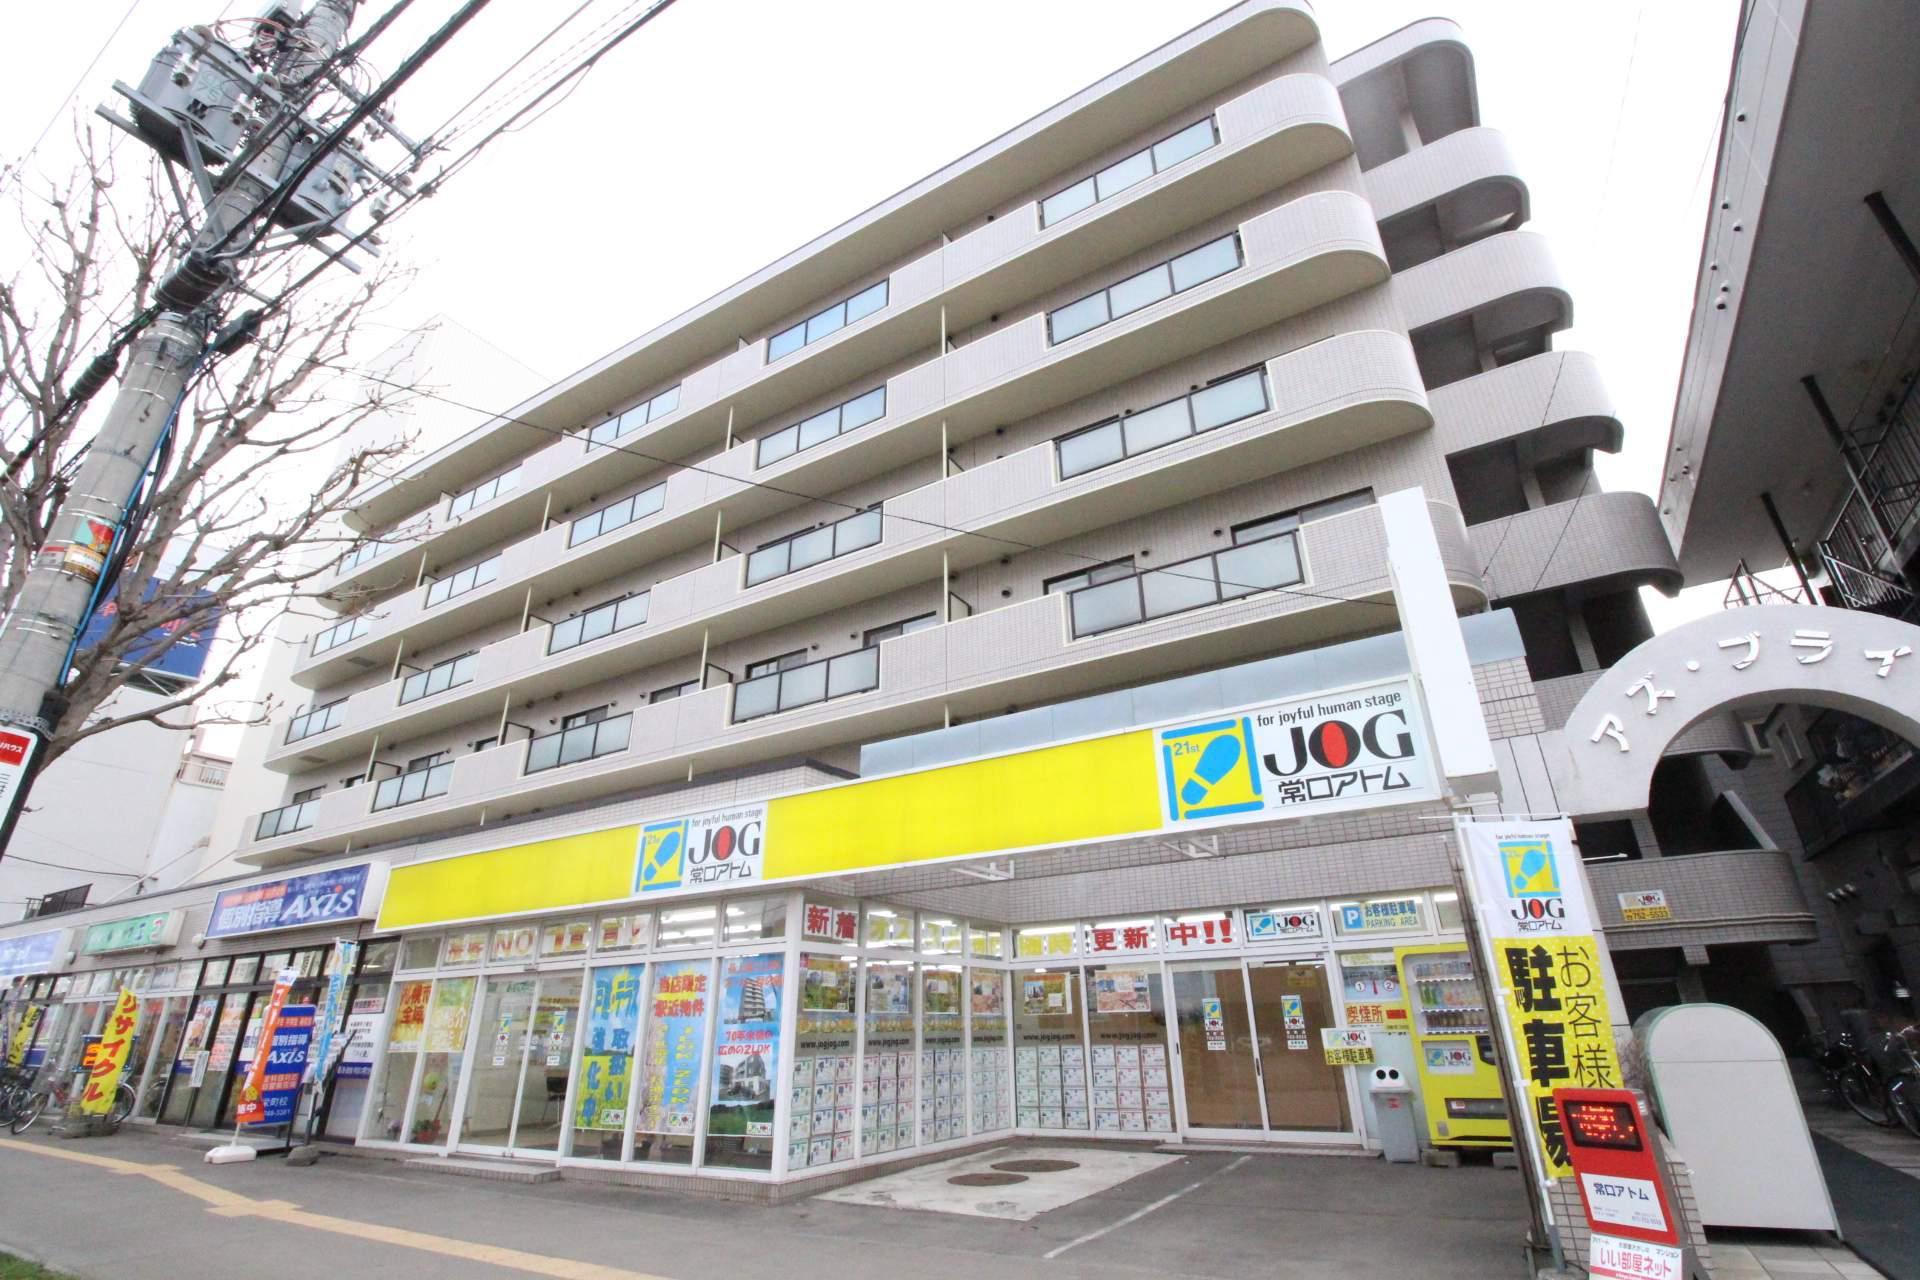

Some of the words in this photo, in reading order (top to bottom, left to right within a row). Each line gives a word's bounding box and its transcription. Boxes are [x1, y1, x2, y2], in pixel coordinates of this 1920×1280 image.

[1257, 714, 1275, 727] for
[1278, 706, 1315, 726] joyful
[1317, 700, 1362, 717] human
[1364, 691, 1402, 708] stage
[1173, 741, 1199, 755] 21st
[1263, 709, 1416, 776] JOG
[1278, 765, 1410, 804] 常口アトム
[688, 821, 761, 864] JOG
[690, 860, 752, 884] 常口アトム
[217, 898, 283, 930] 個別指導
[807, 904, 856, 939] 新着
[1277, 915, 1314, 930] JOG
[1365, 918, 1396, 929] PARKING
[1401, 916, 1418, 926] AREA
[1511, 897, 1565, 920] JOG
[1557, 945, 1615, 1088] お客様
[83, 993, 139, 1103] リサイクル
[1593, 1182, 1649, 1201] 常口アトム
[1599, 1248, 1672, 1277] いい部屋ネット
